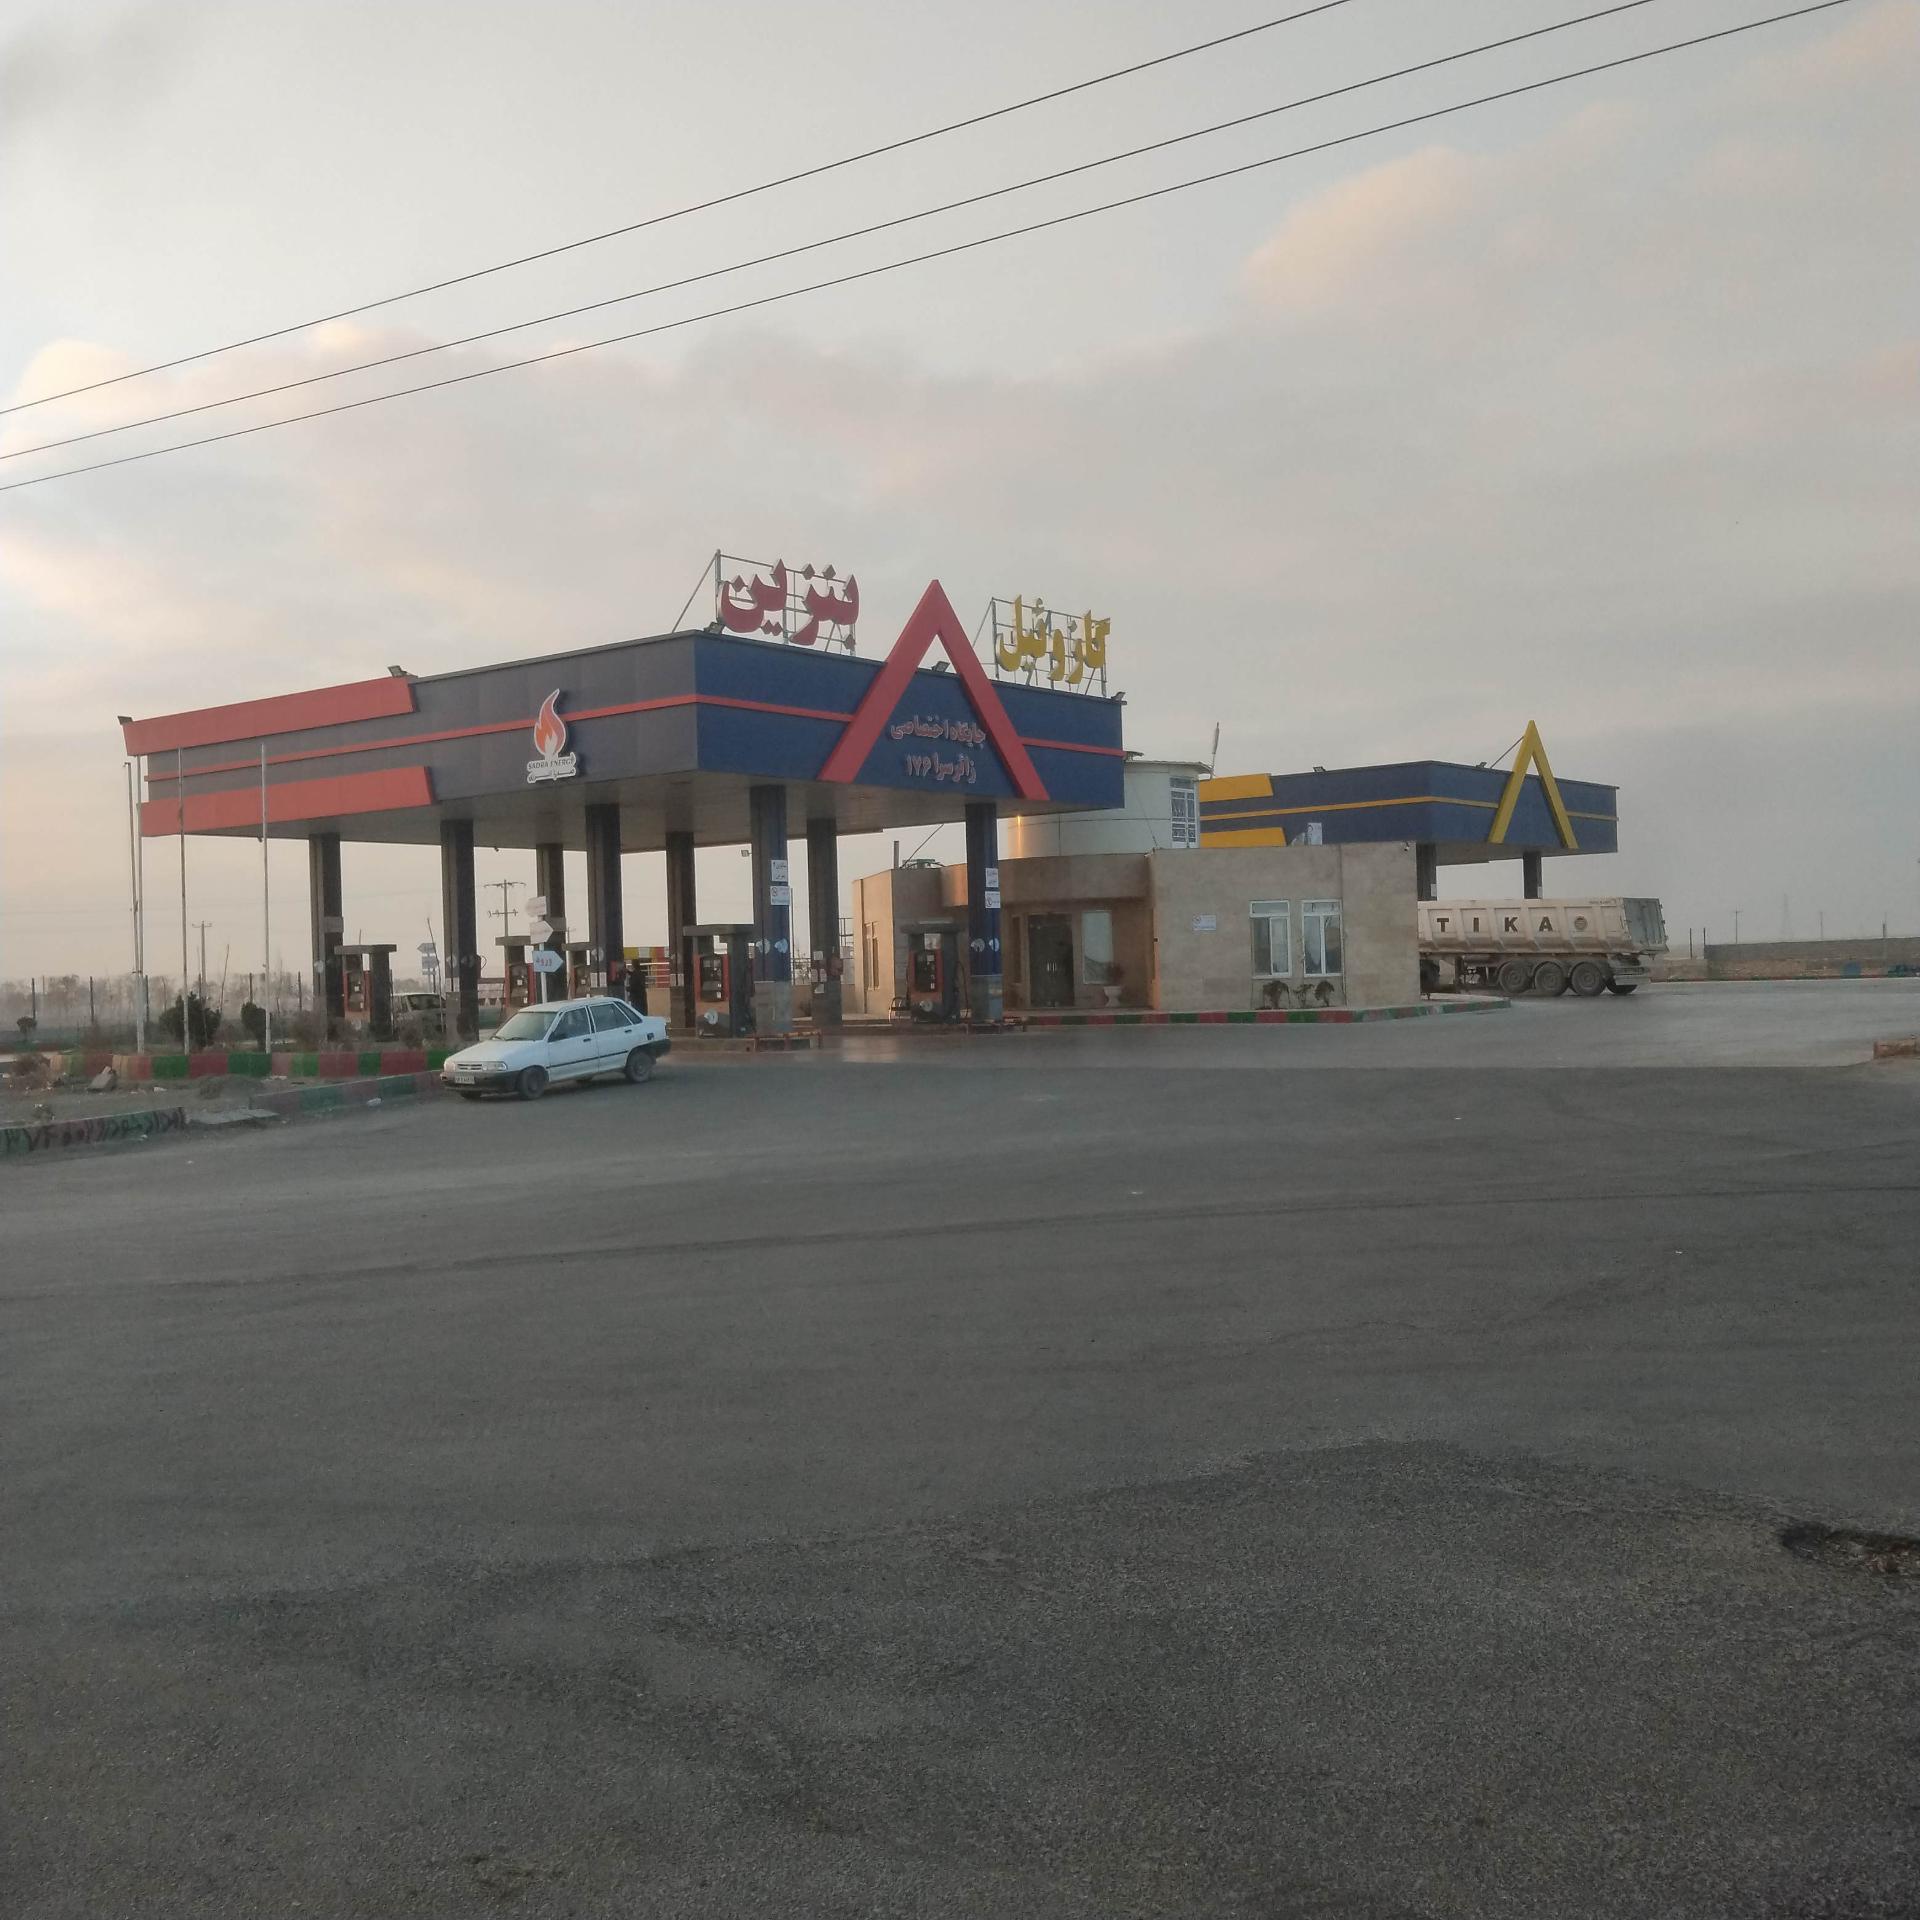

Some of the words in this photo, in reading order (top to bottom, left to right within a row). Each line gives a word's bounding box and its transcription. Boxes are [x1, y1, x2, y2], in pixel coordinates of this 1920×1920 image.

[720, 558, 859, 650] بنزین
[997, 594, 1110, 684] گازوئیل
[890, 714, 948, 740] اختصاصی
[950, 720, 986, 750] جایگاه
[528, 759, 548, 770] SADRA
